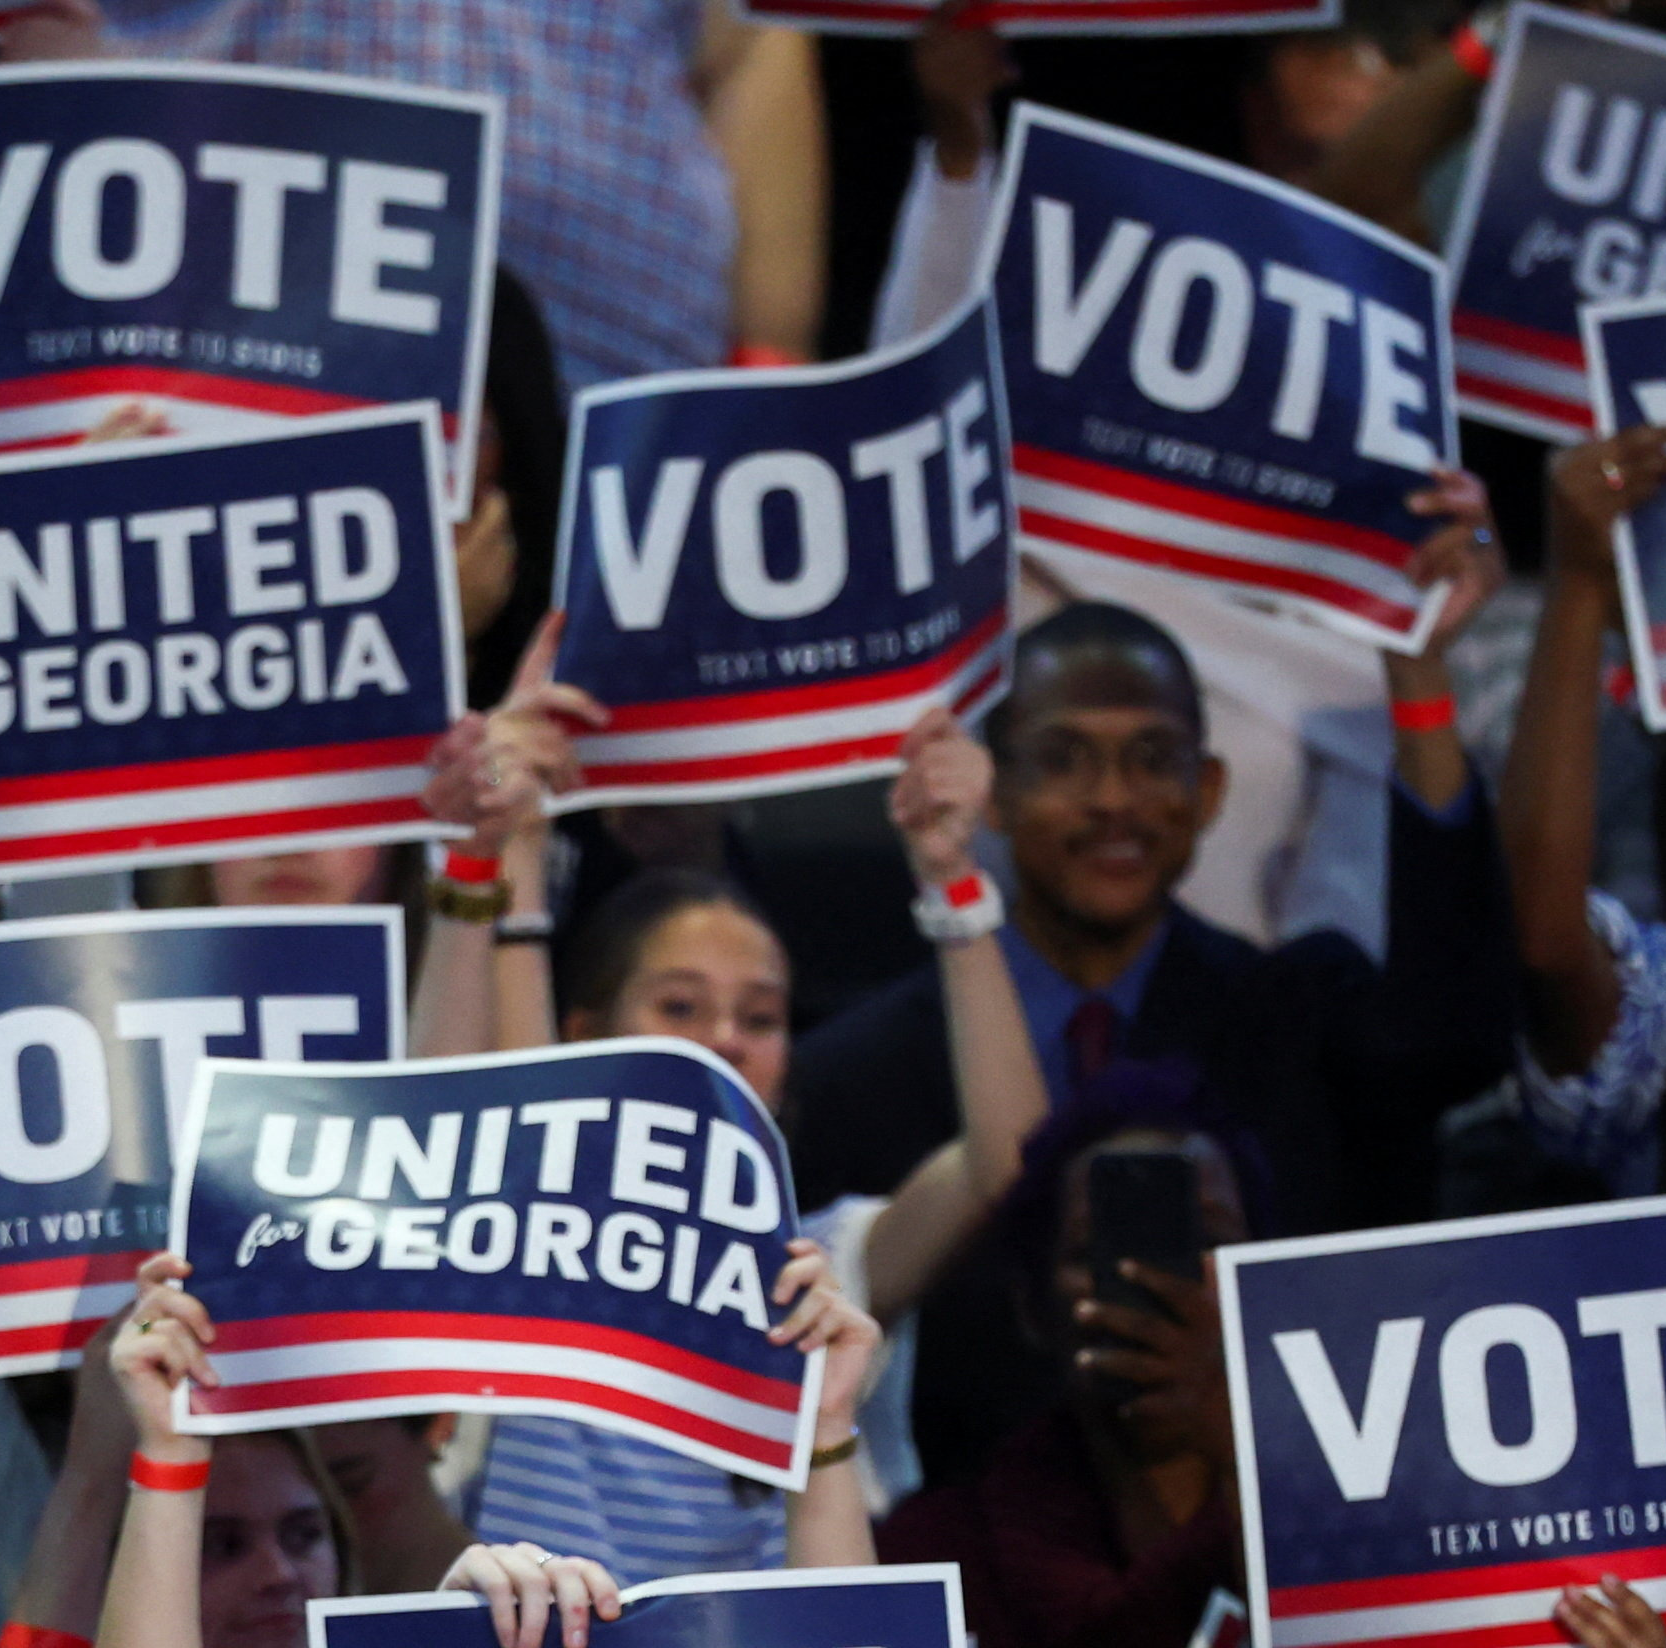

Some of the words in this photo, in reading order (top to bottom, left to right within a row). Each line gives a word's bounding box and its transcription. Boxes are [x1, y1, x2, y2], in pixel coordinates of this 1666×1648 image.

[27, 330, 93, 359] TEXT
[103, 329, 181, 359] VOTE
[191, 334, 228, 362] TO
[1031, 197, 1435, 473] VOTE
[1083, 416, 1144, 458] TEXT
[1146, 432, 1218, 475] VOTE
[1223, 457, 1255, 489] TO
[590, 380, 1004, 632] VOTE
[697, 650, 770, 686] TEXT
[777, 636, 858, 673] VOTE
[867, 631, 903, 665] TO
[250, 1096, 783, 1234] UNITED
[40, 1213, 122, 1244] VOTE
[236, 1211, 305, 1267] for
[305, 1199, 769, 1331] GEORGIA
[1430, 1520, 1501, 1557] TEXT
[1511, 1511, 1594, 1548] VOTE
[1604, 1506, 1636, 1536] TO
